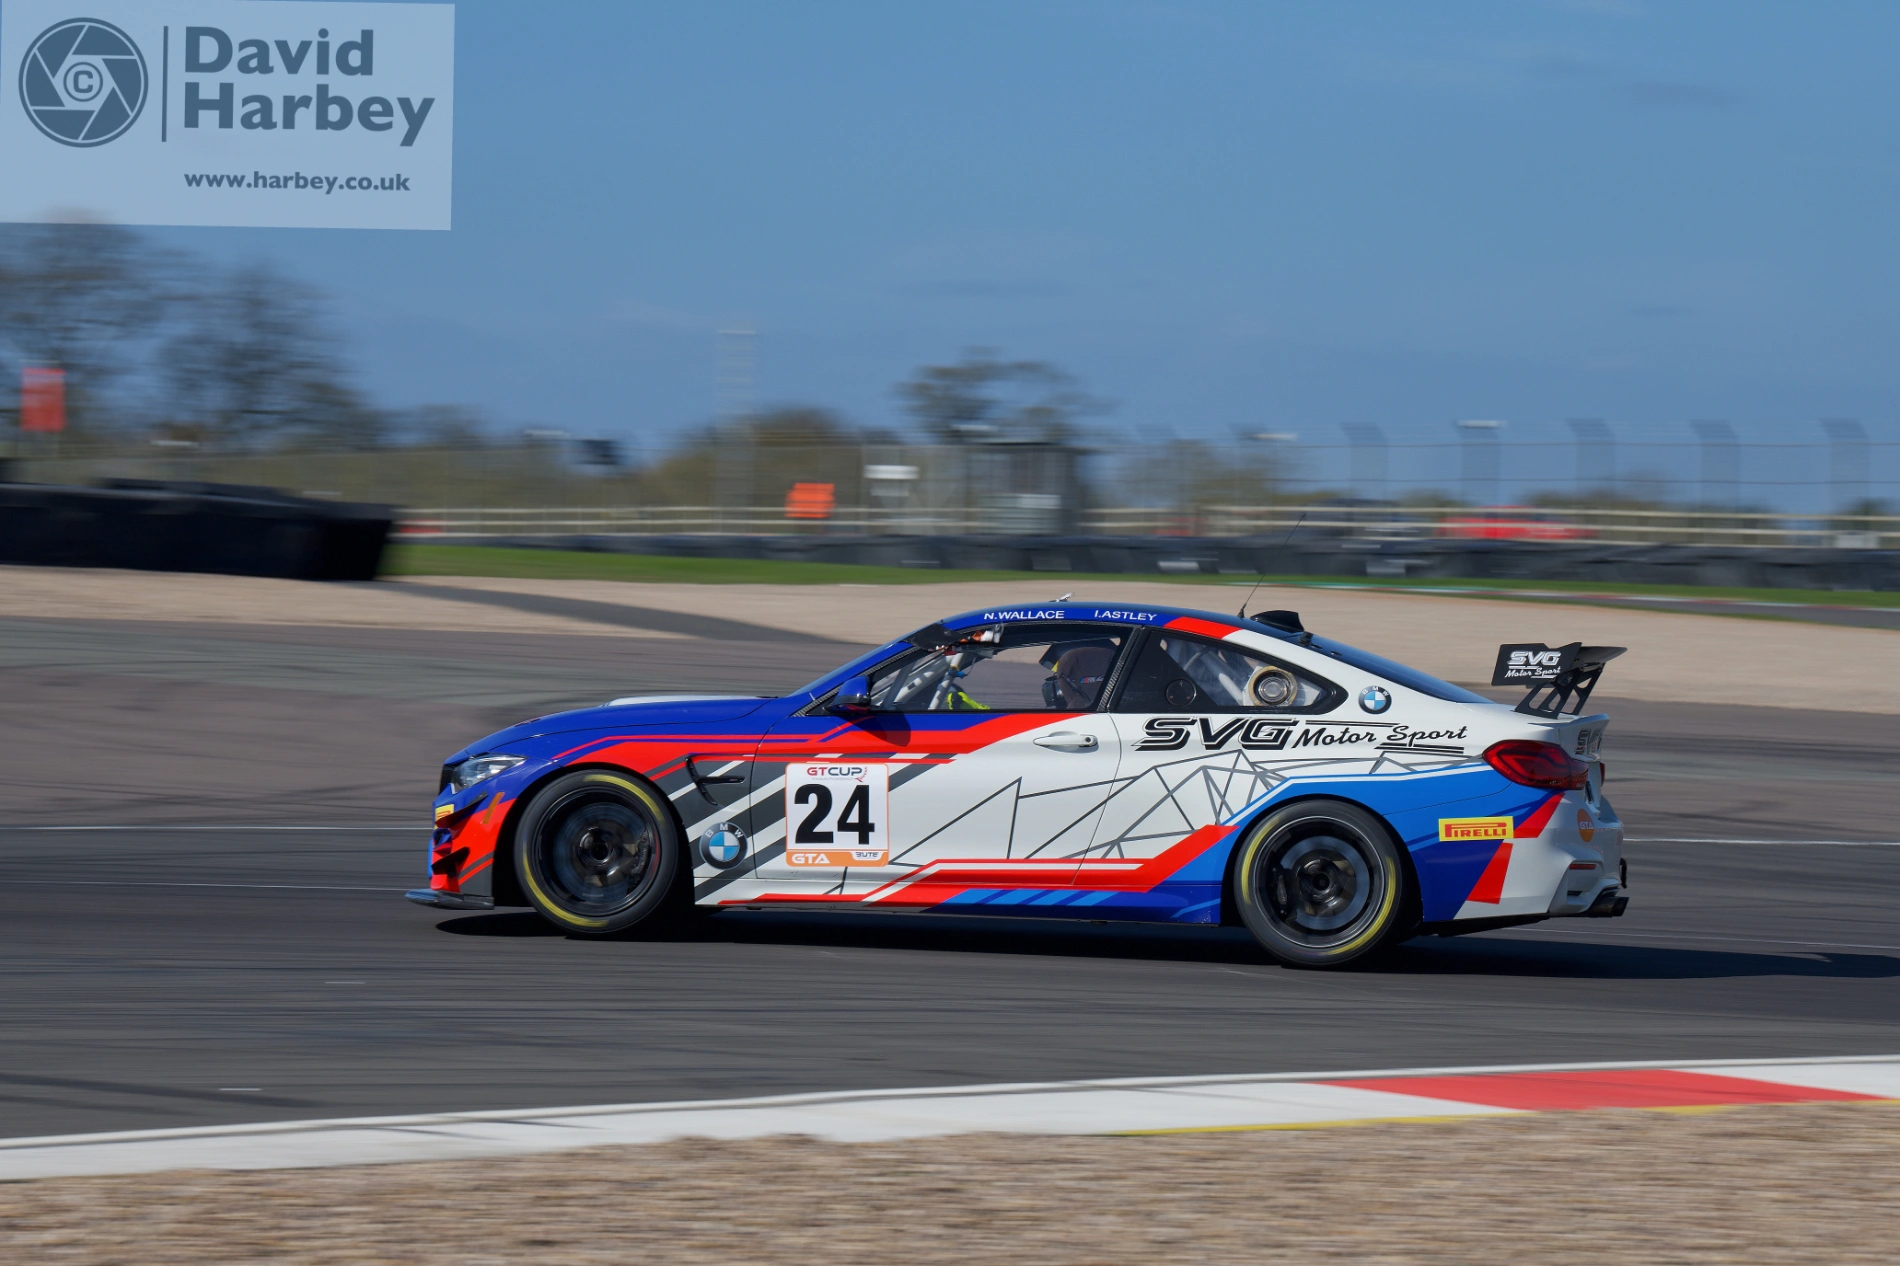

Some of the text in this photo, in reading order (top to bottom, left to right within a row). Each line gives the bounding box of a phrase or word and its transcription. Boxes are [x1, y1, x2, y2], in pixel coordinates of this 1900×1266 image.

[983, 609, 1157, 621] N.WALLACE I.ASTLEY
[1506, 651, 1562, 666] SVG
[1504, 666, 1562, 678] Motor Sport
[1130, 716, 1300, 751] SVG
[1291, 725, 1468, 749] Motor Sport
[793, 783, 875, 845] 24
[1444, 822, 1507, 838] PIRELLI
[791, 853, 831, 864] GTA
